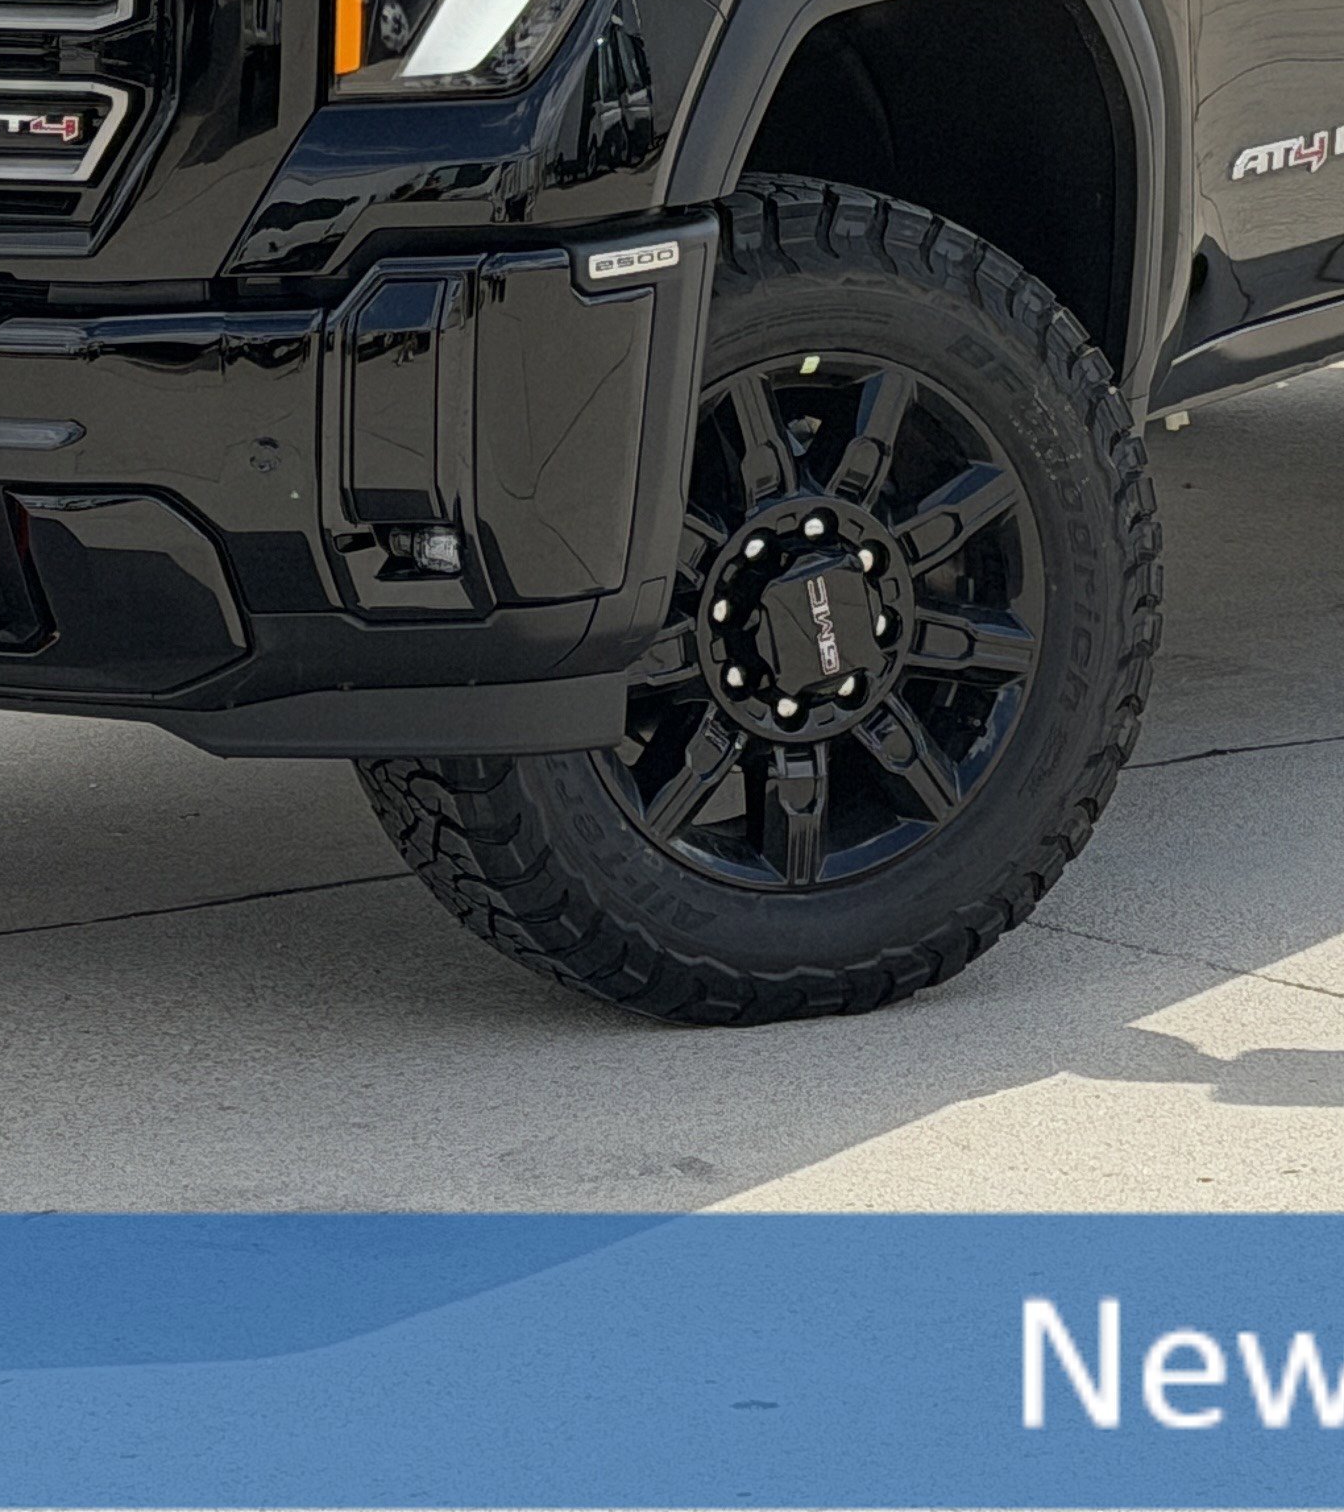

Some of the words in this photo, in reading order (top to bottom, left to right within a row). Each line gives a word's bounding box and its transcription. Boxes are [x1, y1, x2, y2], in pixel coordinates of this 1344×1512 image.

[1230, 130, 1330, 181] AT4
[595, 248, 674, 272] 2500
[806, 574, 841, 676] GMC
